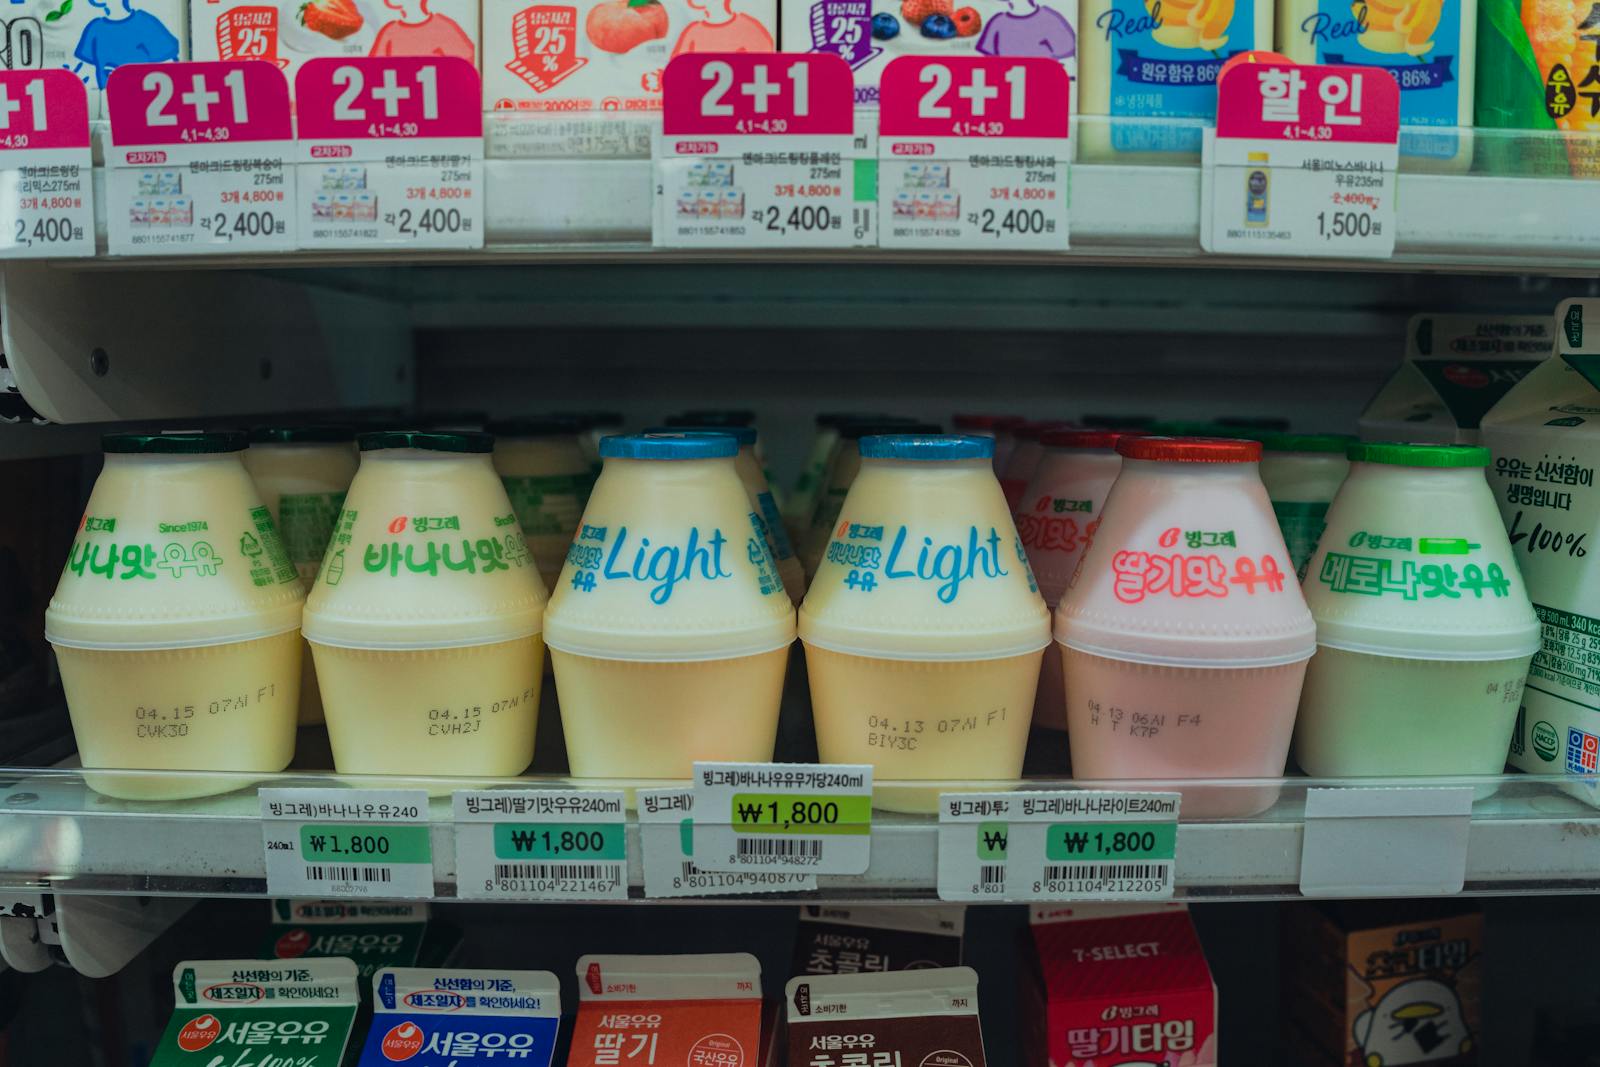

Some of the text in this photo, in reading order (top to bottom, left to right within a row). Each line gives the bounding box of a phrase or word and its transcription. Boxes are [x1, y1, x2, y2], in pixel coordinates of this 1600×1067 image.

[1096, 1, 1164, 41] Real
[1301, 5, 1369, 45] Real
[830, 17, 862, 44] 25
[237, 28, 267, 56] 25
[534, 26, 566, 55] 25
[542, 56, 558, 71] %
[1142, 62, 1194, 82] 원유함유
[1402, 69, 1431, 87] 86%
[332, 65, 438, 121] 2+1
[701, 60, 809, 116] 2+1
[918, 63, 1026, 120] 2+1
[142, 70, 248, 126] 2+1
[854, 135, 867, 149] ml
[254, 174, 283, 185] 275ml
[441, 171, 472, 181] 275ml
[810, 168, 841, 179] 275ml
[1025, 171, 1056, 182] 275ml
[1336, 175, 1384, 188] 우유235ml
[201, 211, 285, 241] 각 2,400원
[385, 209, 472, 237] 각 2,400원
[752, 206, 841, 235] 각 2,400원
[968, 208, 1056, 238] 각 2,400원
[1317, 212, 1381, 240] 1,500원
[15, 218, 83, 247] 2,400원
[1495, 457, 1594, 488] 우유는 신선함이
[1506, 483, 1572, 511] 생명입니다
[84, 517, 116, 533] 빙그레
[158, 521, 209, 534] Since1974
[413, 516, 460, 533] 빙그레
[1185, 530, 1237, 548] 빙그레
[1367, 535, 1413, 551] 빙그레
[603, 526, 732, 605] Light
[885, 525, 1008, 603] Light
[843, 569, 878, 592] 우유
[1547, 611, 1559, 624] 500
[1571, 615, 1587, 631] 340
[136, 706, 194, 721] 04.15
[428, 706, 482, 721] 04.15
[1177, 714, 1202, 727] F4
[868, 715, 925, 734] 04.13
[703, 770, 863, 789] 빙그레)바나나우유무가당240ml
[269, 803, 418, 818] 빙그레)바나나우유240
[466, 797, 620, 814] 빙그레)딸기맛우유240ml
[1023, 799, 1175, 814] 빙그레)바나나라이트240ml
[267, 835, 389, 855] 240ml ₩1,800
[729, 855, 736, 864] 8
[485, 880, 493, 891] 8
[673, 877, 681, 889] 8
[972, 884, 979, 893] 8
[1033, 882, 1041, 892] 8
[308, 933, 404, 954] 서울우유
[1072, 942, 1160, 963] 7-SELECT
[232, 970, 283, 982] 신선함의
[433, 978, 485, 991] 신선함의
[278, 987, 339, 999] 확인하세요!
[479, 996, 541, 1010] 확인하세요!
[952, 998, 968, 1008] 까지
[598, 1014, 662, 1029] 서울우유
[216, 1020, 330, 1045] 서울우유
[809, 1033, 876, 1050] 서울우유
[1068, 1020, 1194, 1059] 딸기타임
[421, 1031, 534, 1058] 서울우유
[593, 1032, 658, 1065] 딸기
[694, 1050, 738, 1066] 국산우유
